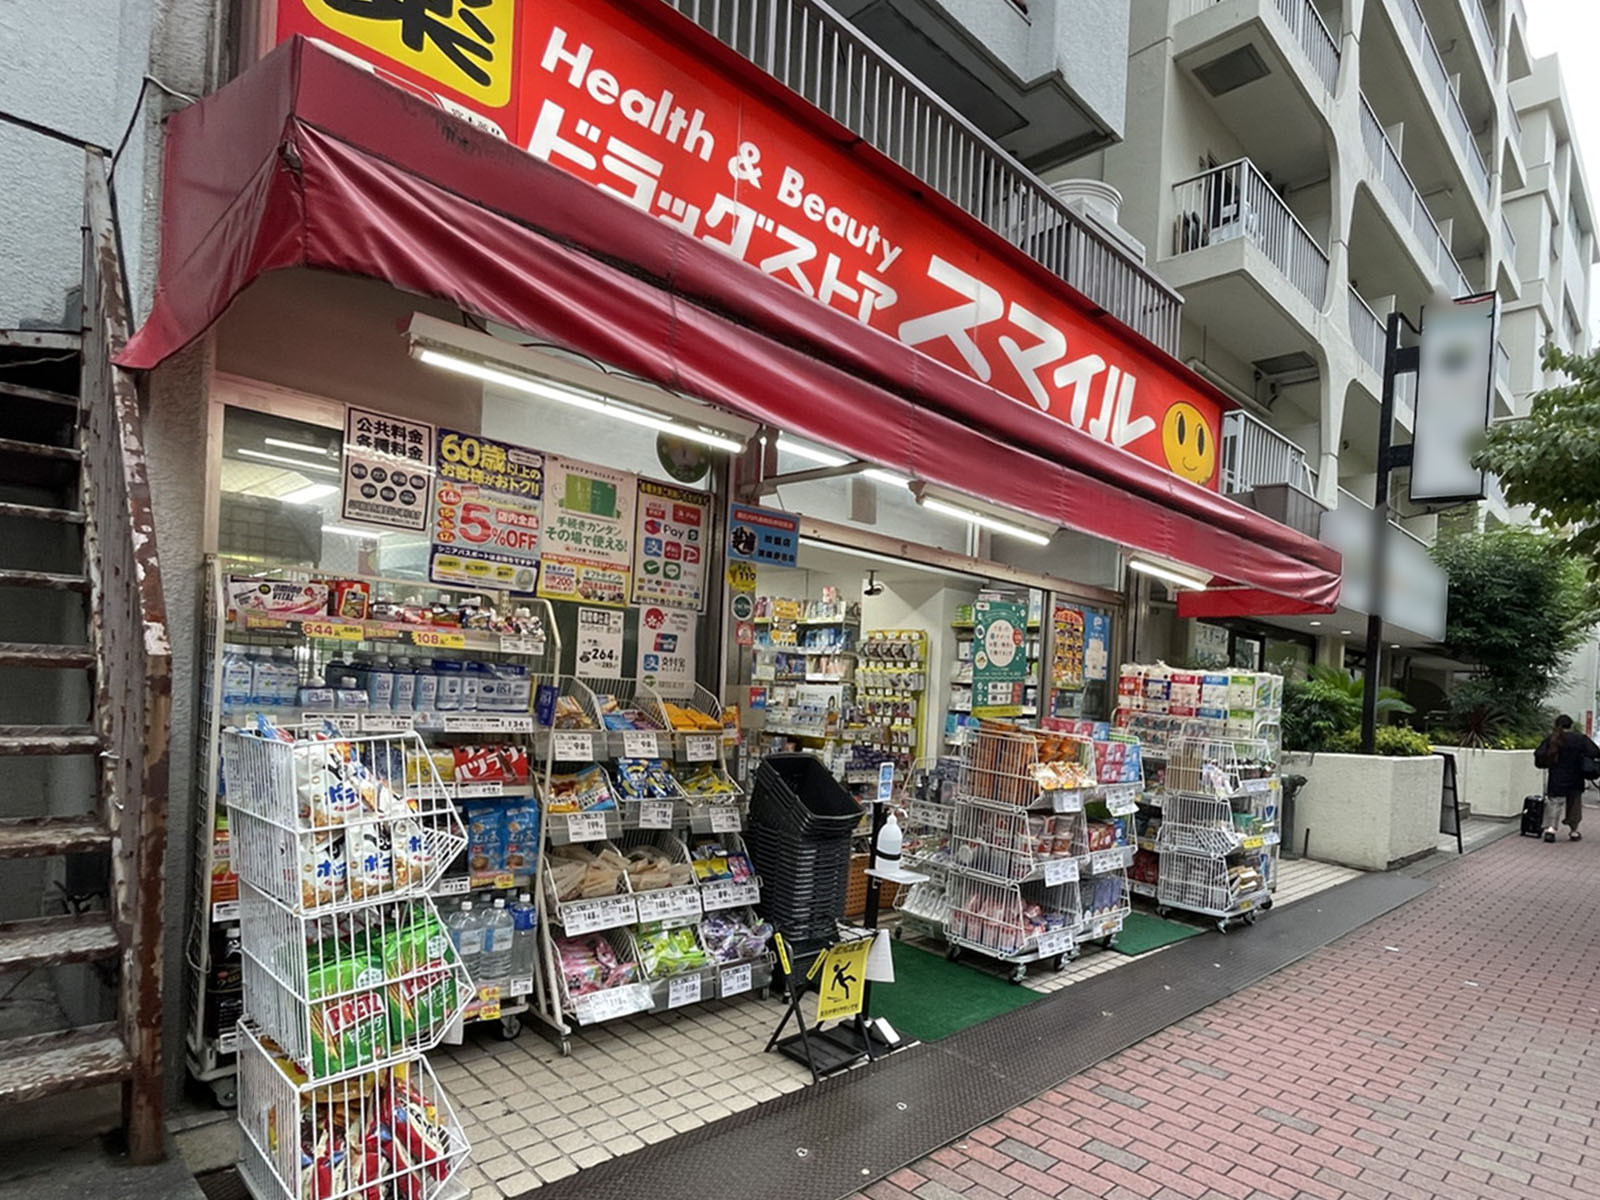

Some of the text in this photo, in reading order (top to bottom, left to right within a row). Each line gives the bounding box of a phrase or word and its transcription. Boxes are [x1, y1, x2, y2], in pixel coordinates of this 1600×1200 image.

[541, 26, 715, 162] Health
[728, 142, 764, 191] &
[777, 166, 902, 272] Beauty
[526, 100, 898, 326] ドラッグストア
[899, 254, 1156, 449] スマイル
[357, 417, 424, 446] 公共料金
[546, 526, 628, 553] その場で使える!
[556, 516, 622, 537] 手続きカンタン
[664, 524, 685, 540] Pay
[303, 623, 333, 635] 644
[416, 633, 439, 644] 108
[328, 994, 382, 1031] PRETZ
